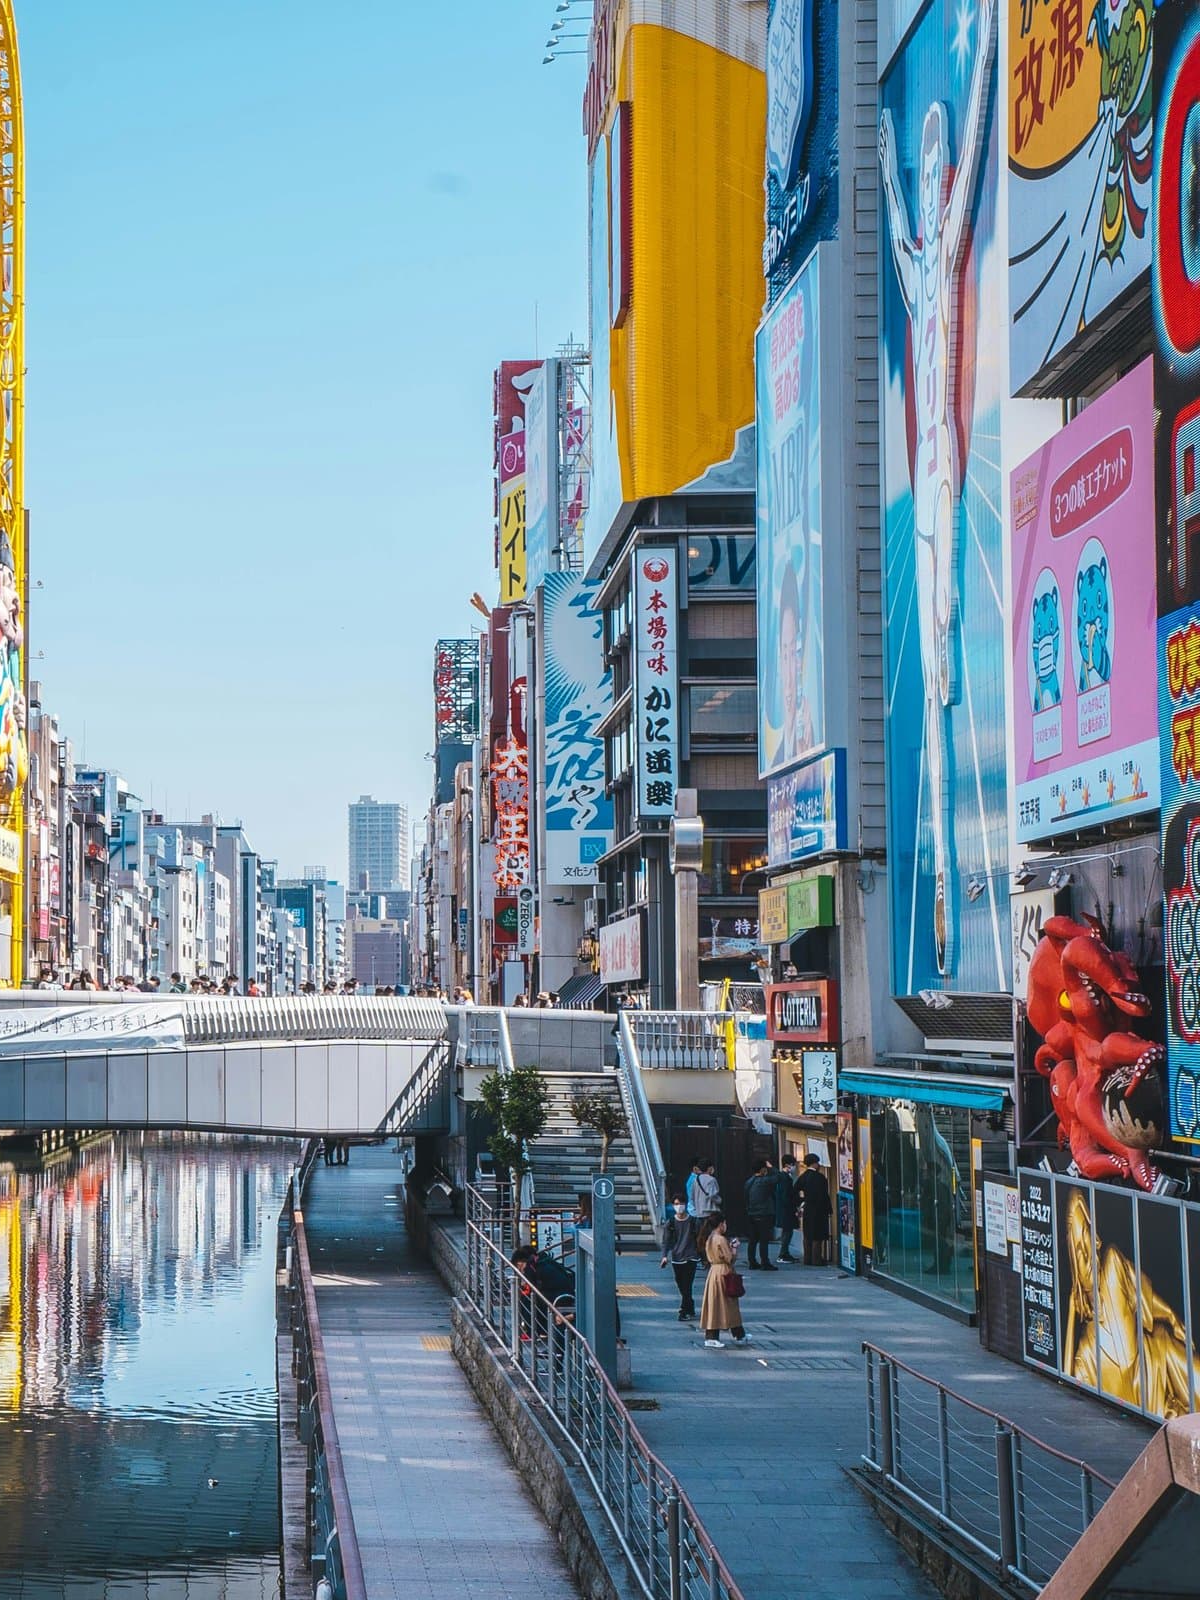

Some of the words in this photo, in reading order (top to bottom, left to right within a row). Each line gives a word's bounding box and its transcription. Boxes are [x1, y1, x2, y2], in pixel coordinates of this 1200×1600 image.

[924, 302, 938, 479] グリコ
[646, 588, 668, 677] 本場の味
[645, 686, 673, 806] かに道楽
[782, 996, 818, 1028] LOTTERIA
[1029, 1186, 1042, 1201] 2022
